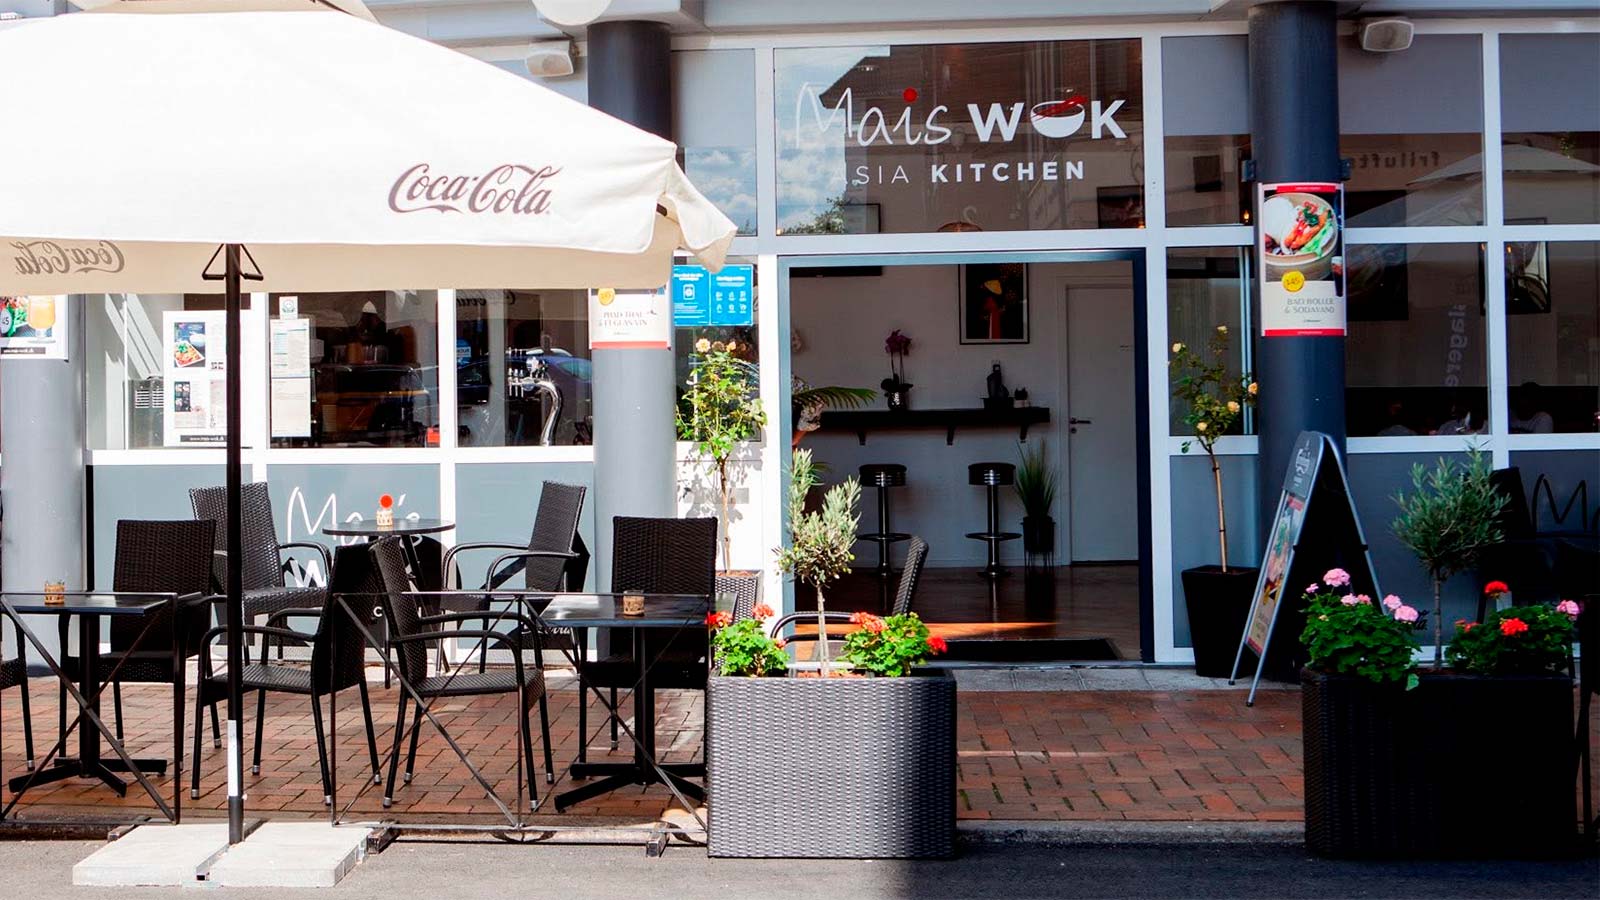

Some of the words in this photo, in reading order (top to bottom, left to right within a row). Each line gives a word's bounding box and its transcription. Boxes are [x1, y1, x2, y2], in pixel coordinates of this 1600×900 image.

[797, 82, 952, 148] Mais
[388, 163, 563, 215] Coca-Cola
[932, 161, 1084, 183] KITCHEN
